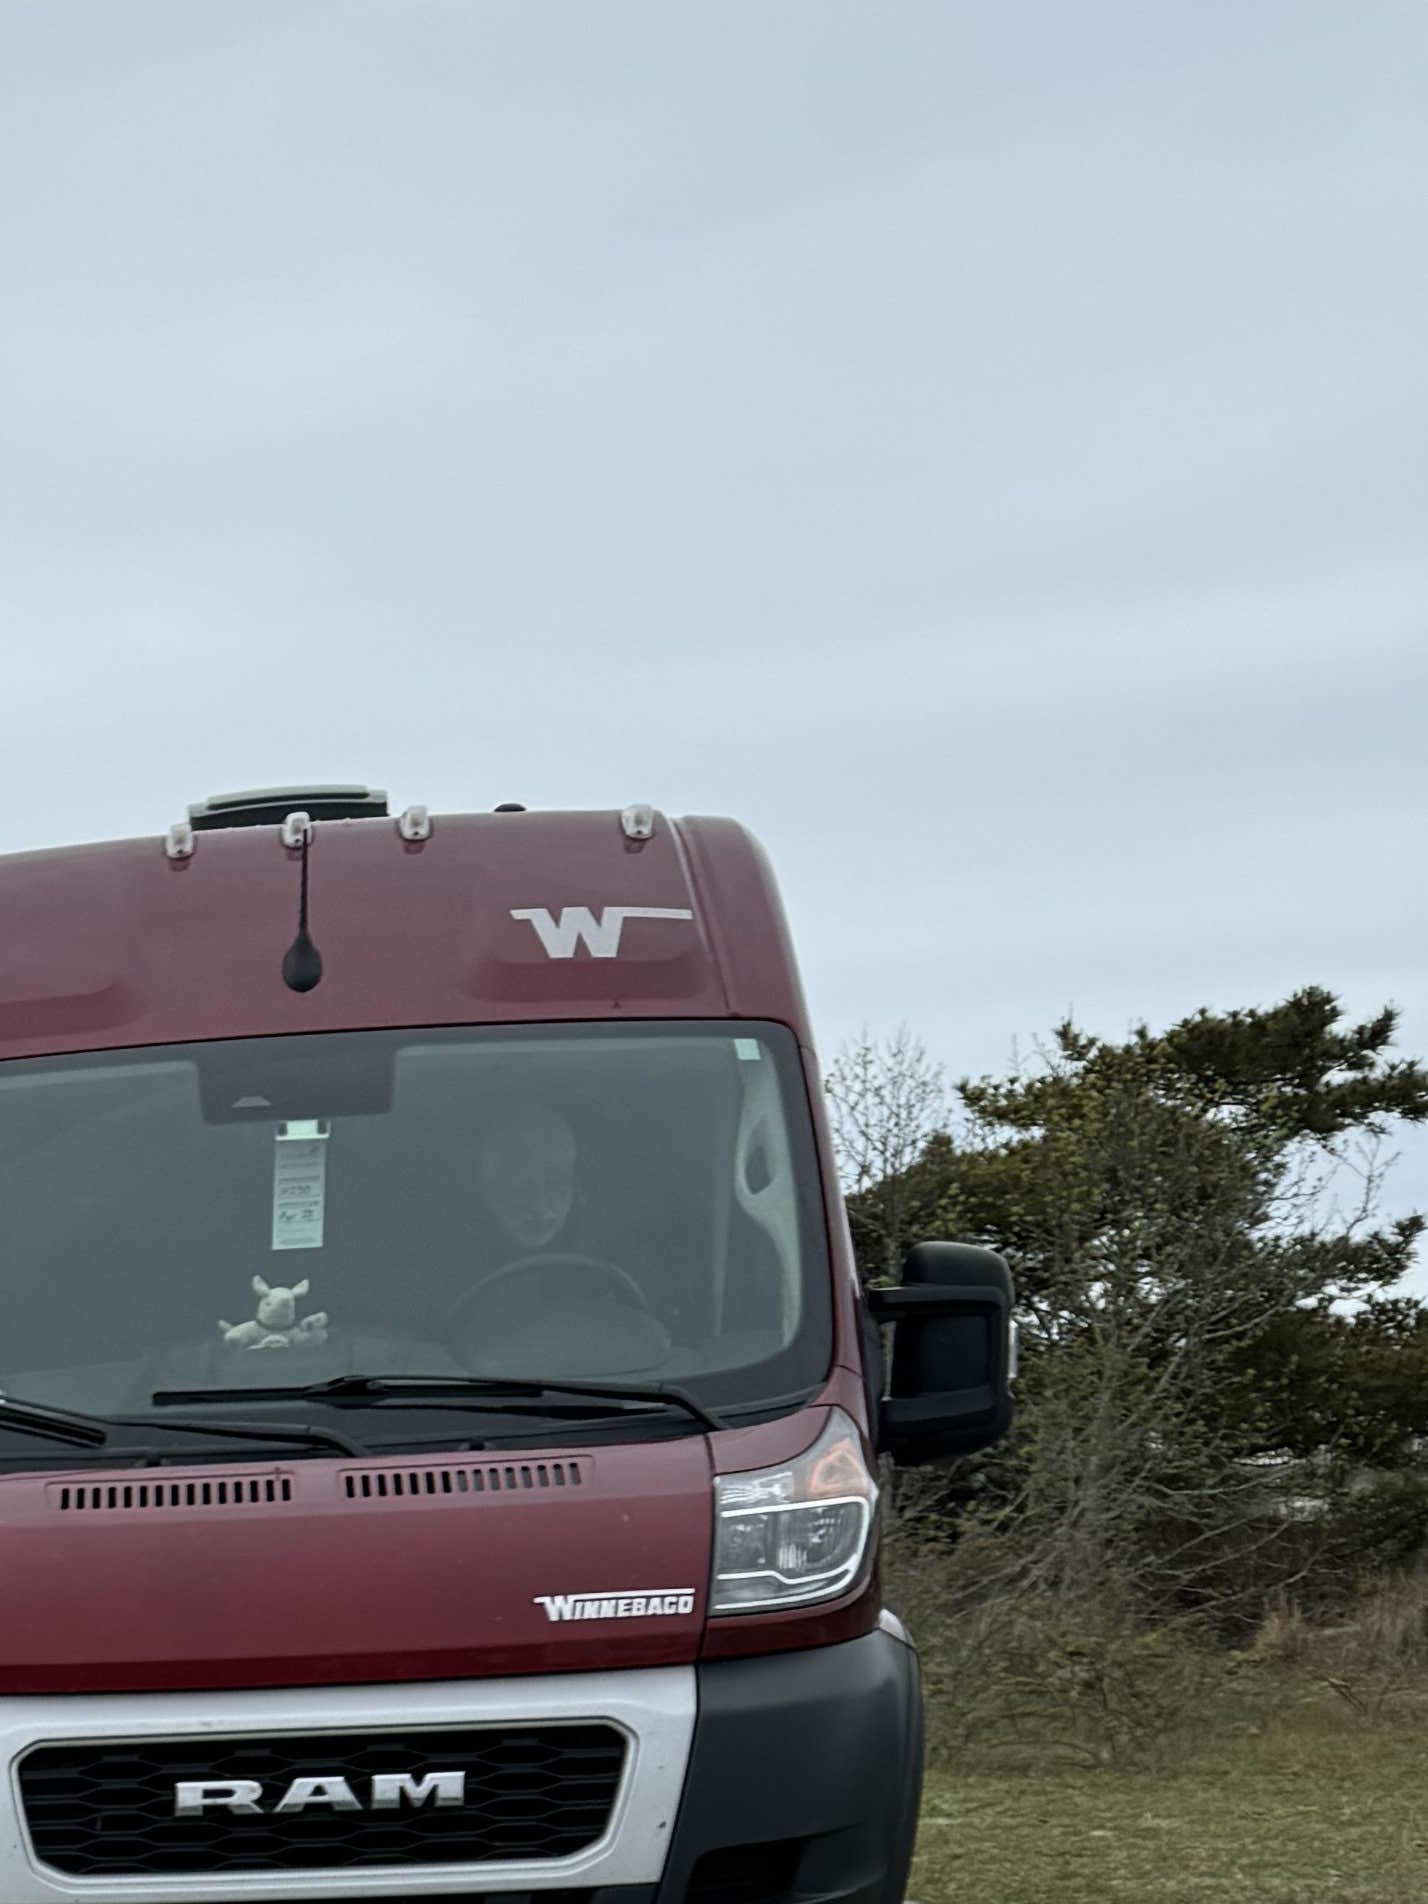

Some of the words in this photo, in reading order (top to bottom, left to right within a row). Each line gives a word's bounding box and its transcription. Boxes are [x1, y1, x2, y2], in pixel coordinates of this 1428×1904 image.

[509, 906, 694, 959] W
[533, 1587, 696, 1622] WINNEBAGO
[174, 1771, 466, 1816] RAM
